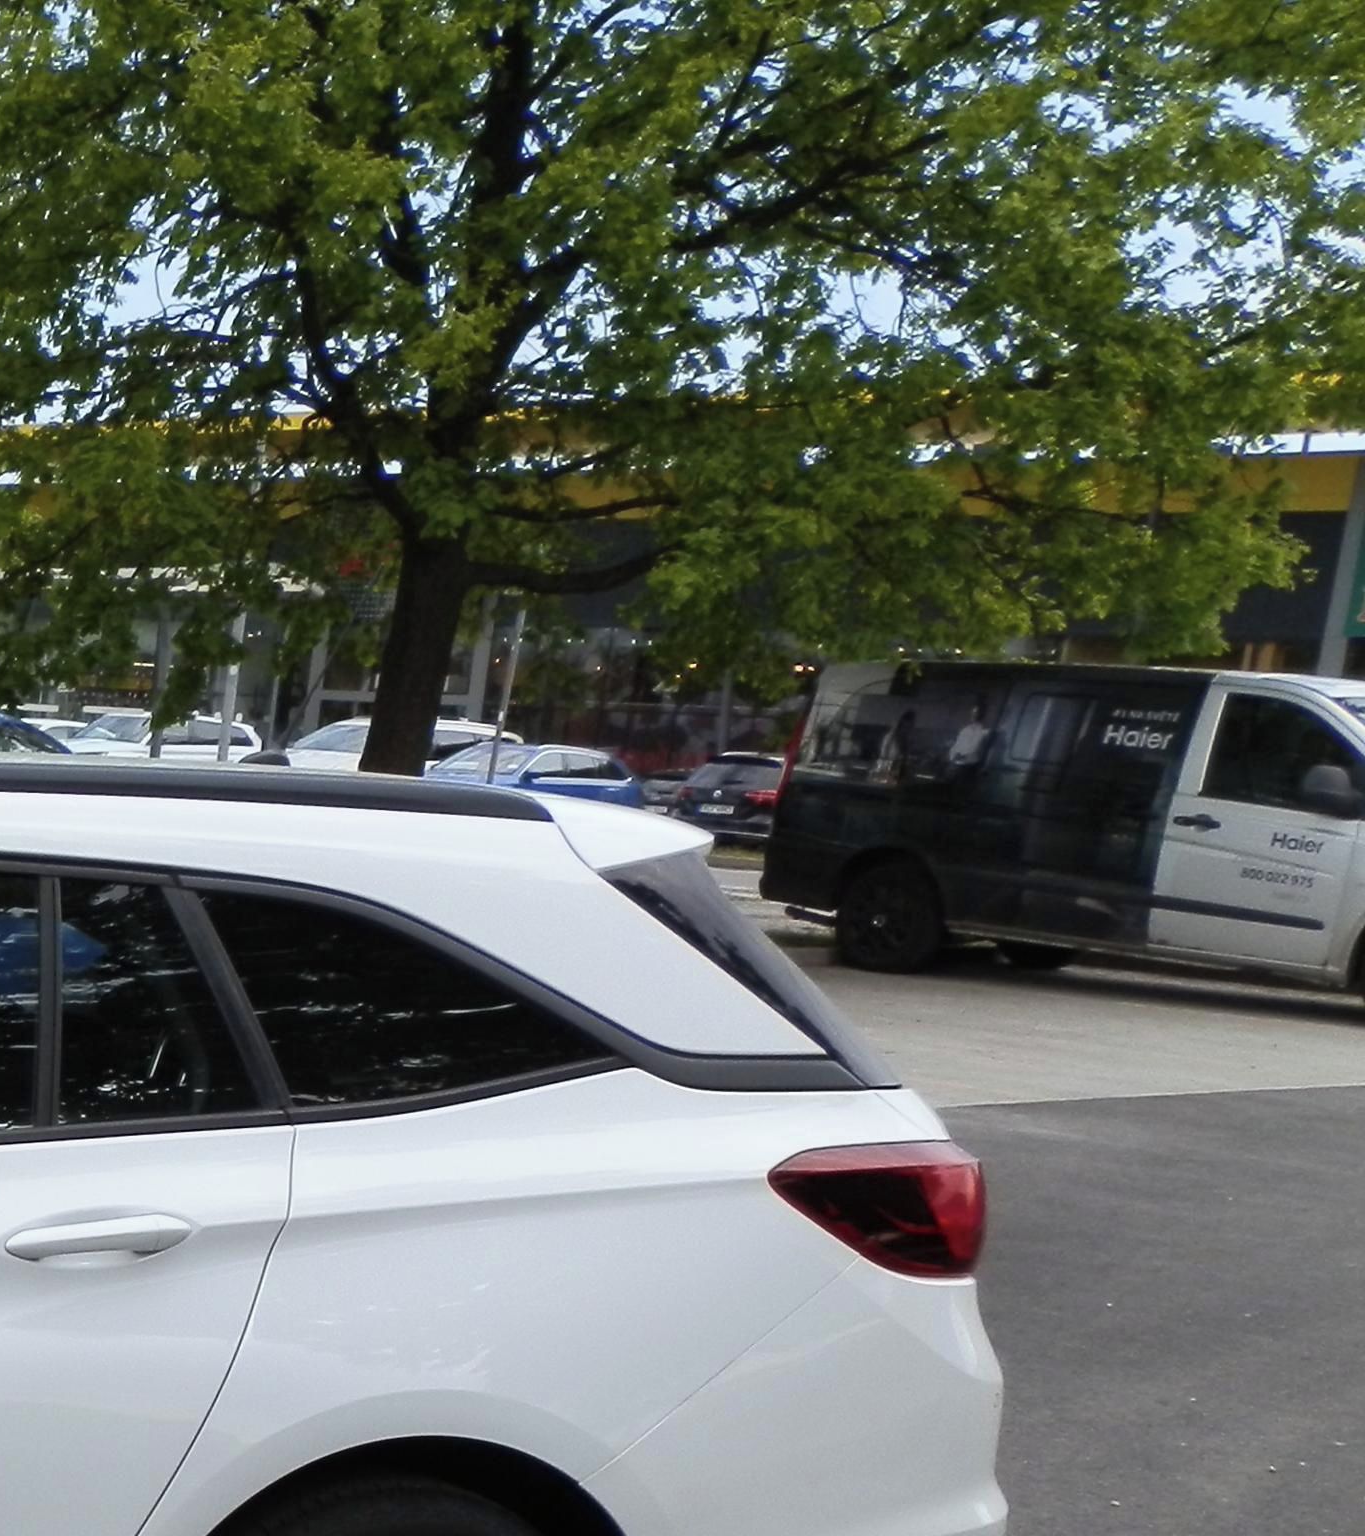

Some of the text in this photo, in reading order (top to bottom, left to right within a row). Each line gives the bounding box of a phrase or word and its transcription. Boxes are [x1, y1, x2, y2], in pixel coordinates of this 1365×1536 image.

[1102, 724, 1174, 750] Haier
[1270, 832, 1326, 854] Haier
[1240, 867, 1264, 881] 800
